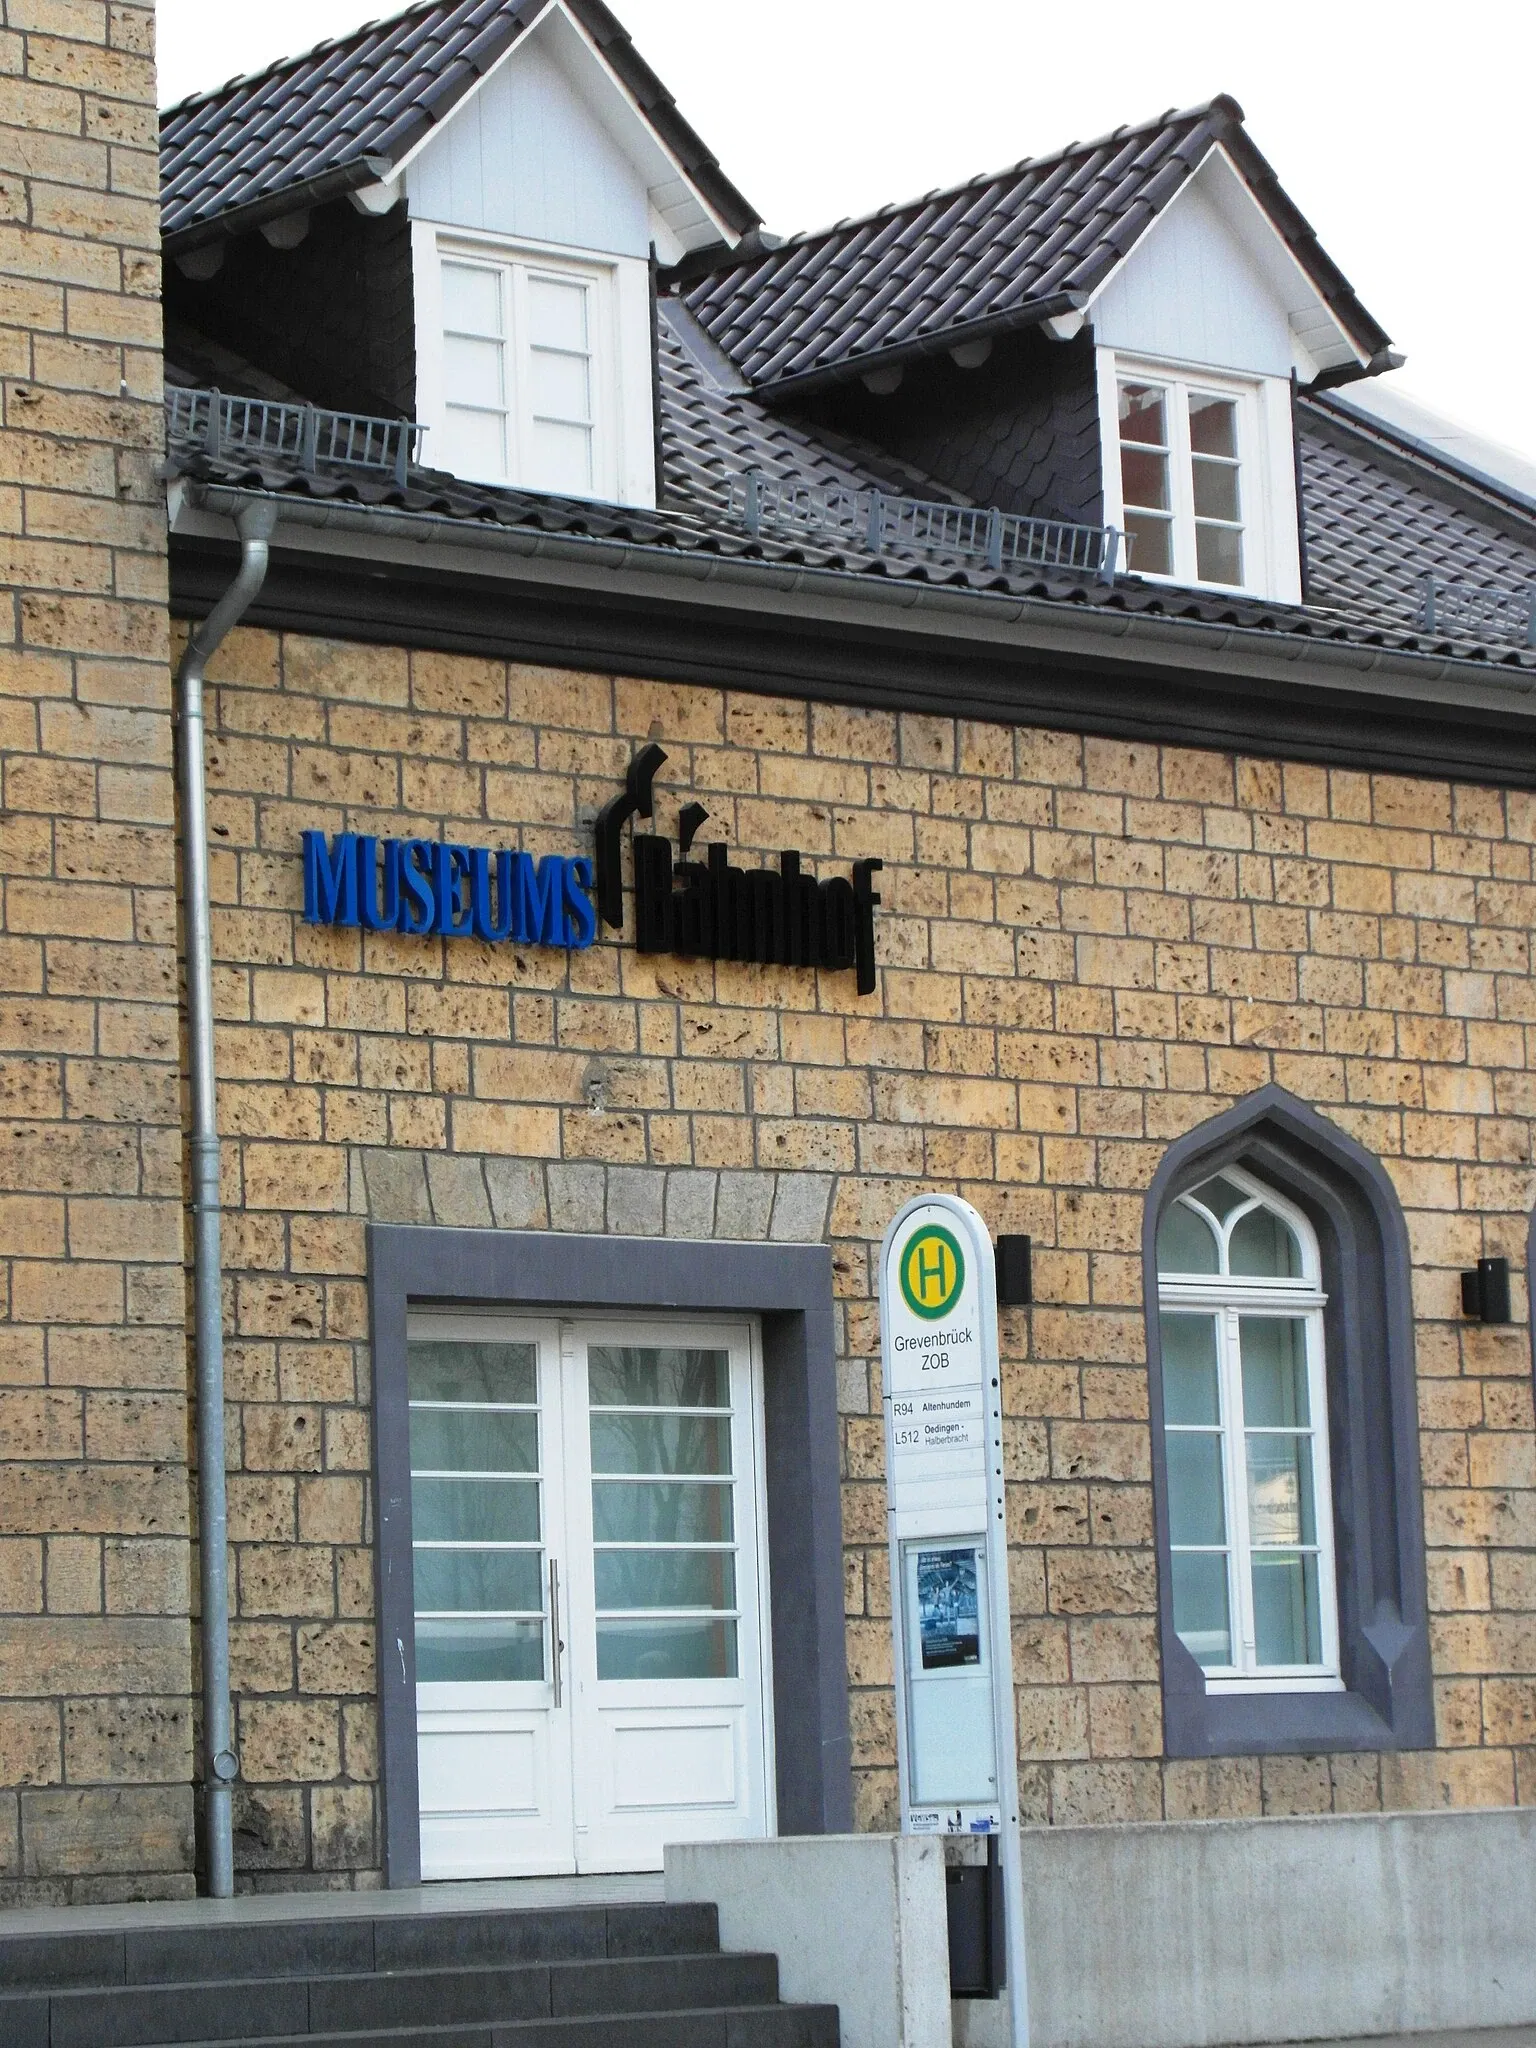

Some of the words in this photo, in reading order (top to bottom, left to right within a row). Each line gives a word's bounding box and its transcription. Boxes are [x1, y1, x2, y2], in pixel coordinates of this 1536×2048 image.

[301, 829, 596, 951] MUSEUMS
[634, 833, 883, 997] Bahnhof
[918, 1244, 946, 1300] H
[894, 1327, 973, 1352] Grevenbrück
[921, 1352, 950, 1371] ZOB
[893, 1402, 914, 1417] R94
[922, 1399, 971, 1412] Altenhundem
[895, 1430, 919, 1445] L512
[924, 1423, 960, 1435] Oedingen
[924, 1433, 969, 1446] Halberbracht
